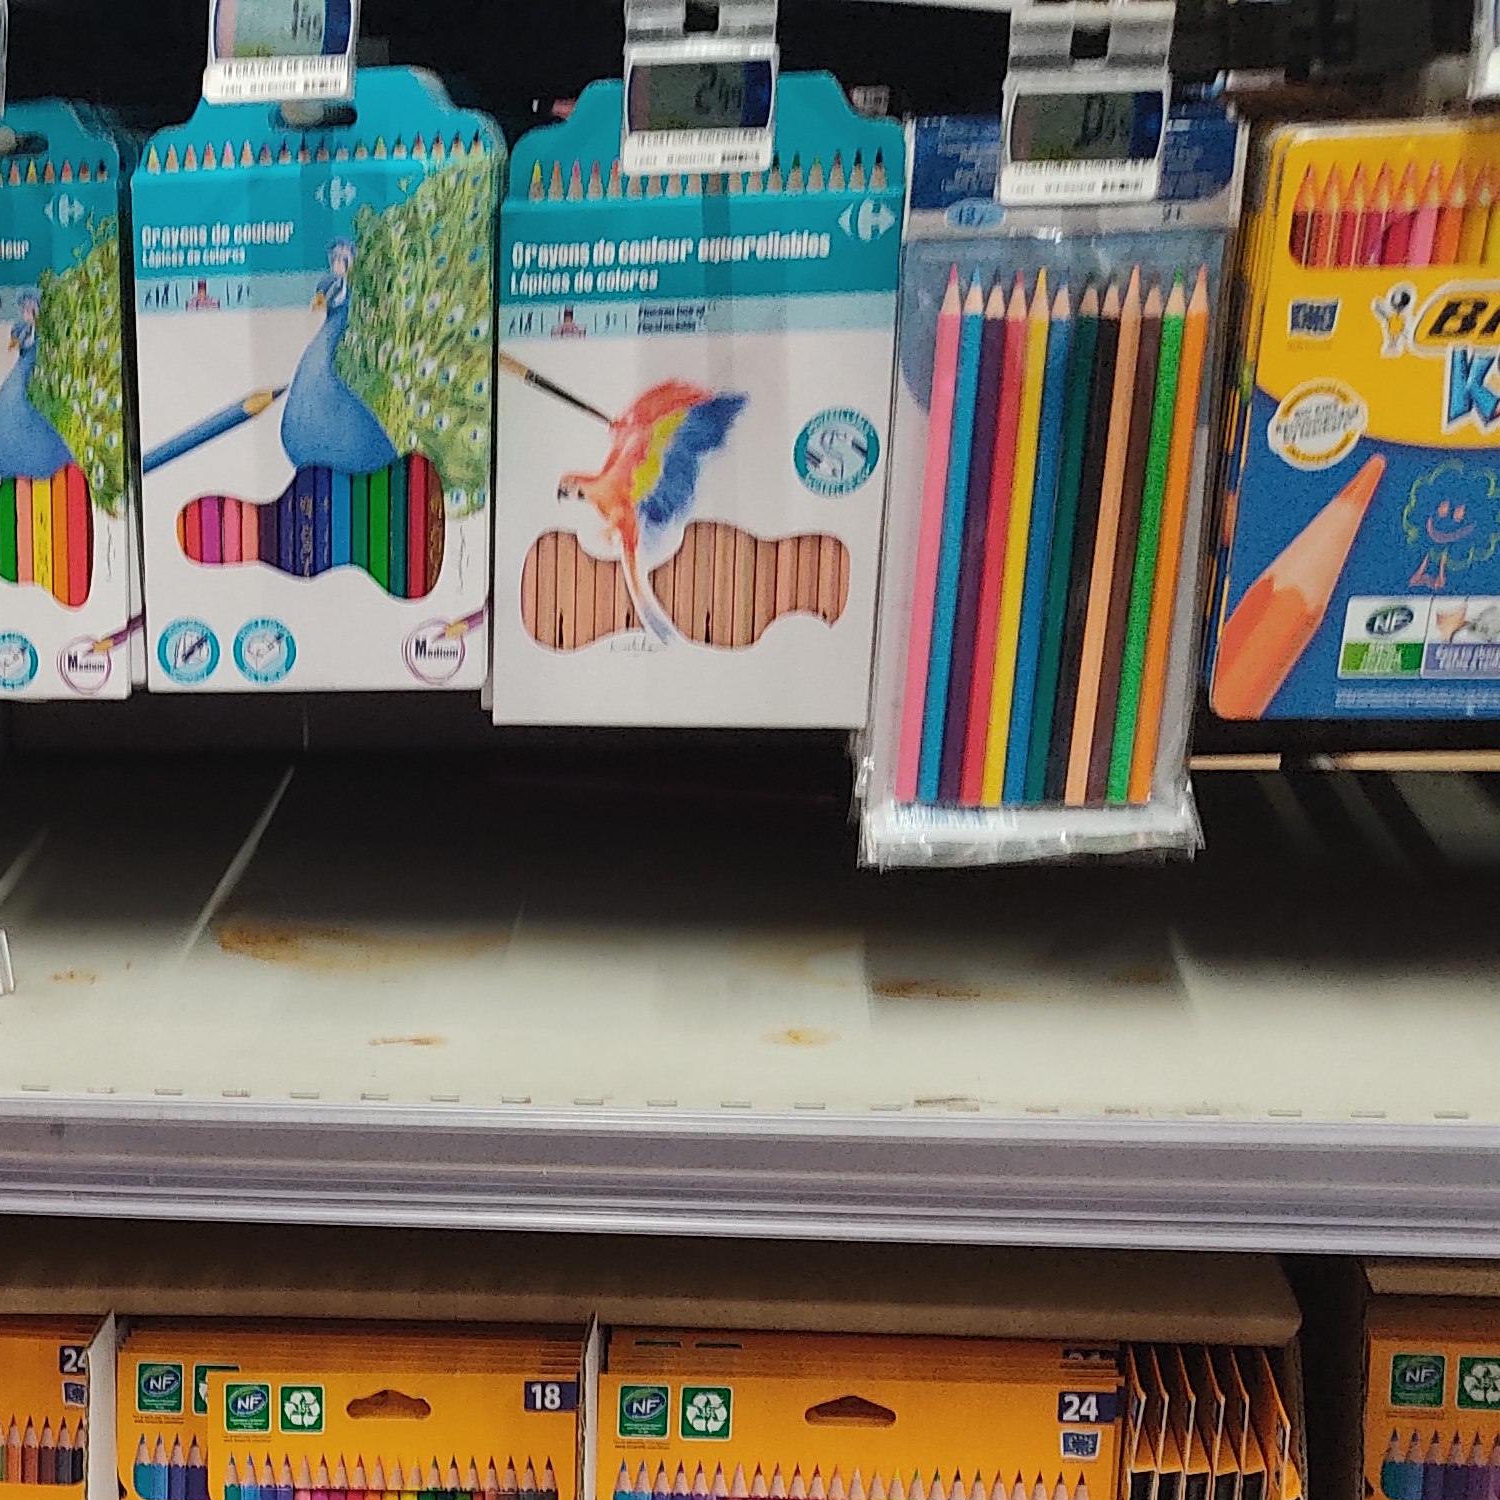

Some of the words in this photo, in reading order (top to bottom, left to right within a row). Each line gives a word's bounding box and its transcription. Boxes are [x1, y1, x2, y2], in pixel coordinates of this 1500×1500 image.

[512, 241, 590, 270] Crayons
[593, 238, 615, 267] de
[618, 235, 693, 265] couleur
[574, 269, 593, 294] de
[415, 638, 459, 661] Medium
[150, 1373, 176, 1391] NF
[1405, 1366, 1436, 1382] NF
[237, 1395, 263, 1410] NF
[532, 1384, 561, 1410] 18
[632, 1398, 660, 1414] NF
[1062, 1393, 1099, 1422] 24
